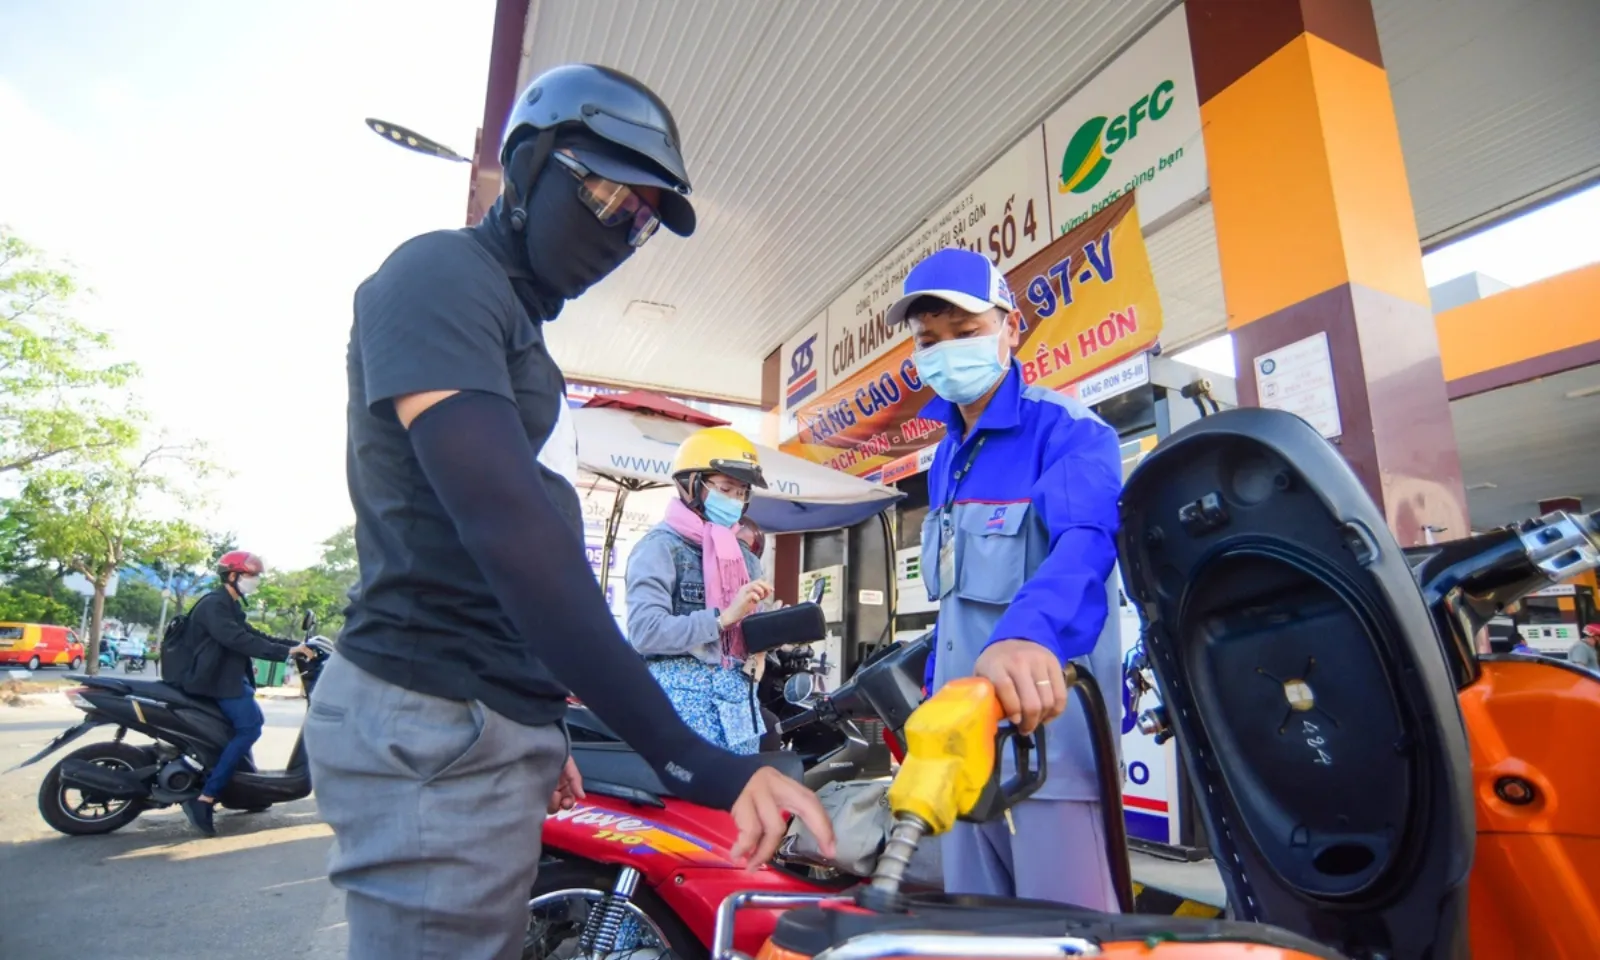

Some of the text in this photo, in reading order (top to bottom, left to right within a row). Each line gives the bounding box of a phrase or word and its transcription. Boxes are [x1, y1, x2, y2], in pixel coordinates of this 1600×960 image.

[1104, 79, 1174, 155] SFC
[1124, 166, 1155, 194] cùng
[1158, 147, 1184, 172] bạn
[953, 218, 966, 240] SÀI
[968, 202, 986, 228] GÒN
[832, 326, 855, 377] CỬA
[988, 193, 1016, 268] SỐ
[1023, 198, 1037, 242] 4
[1026, 228, 1115, 319] 97-V
[1021, 342, 1072, 385] BỀN
[1077, 306, 1138, 359] HƠN
[808, 398, 858, 444] XĂNG
[854, 370, 901, 418] CAO
[1103, 373, 1120, 390] RON
[857, 431, 892, 461] HƠN
[591, 829, 645, 845] 110
